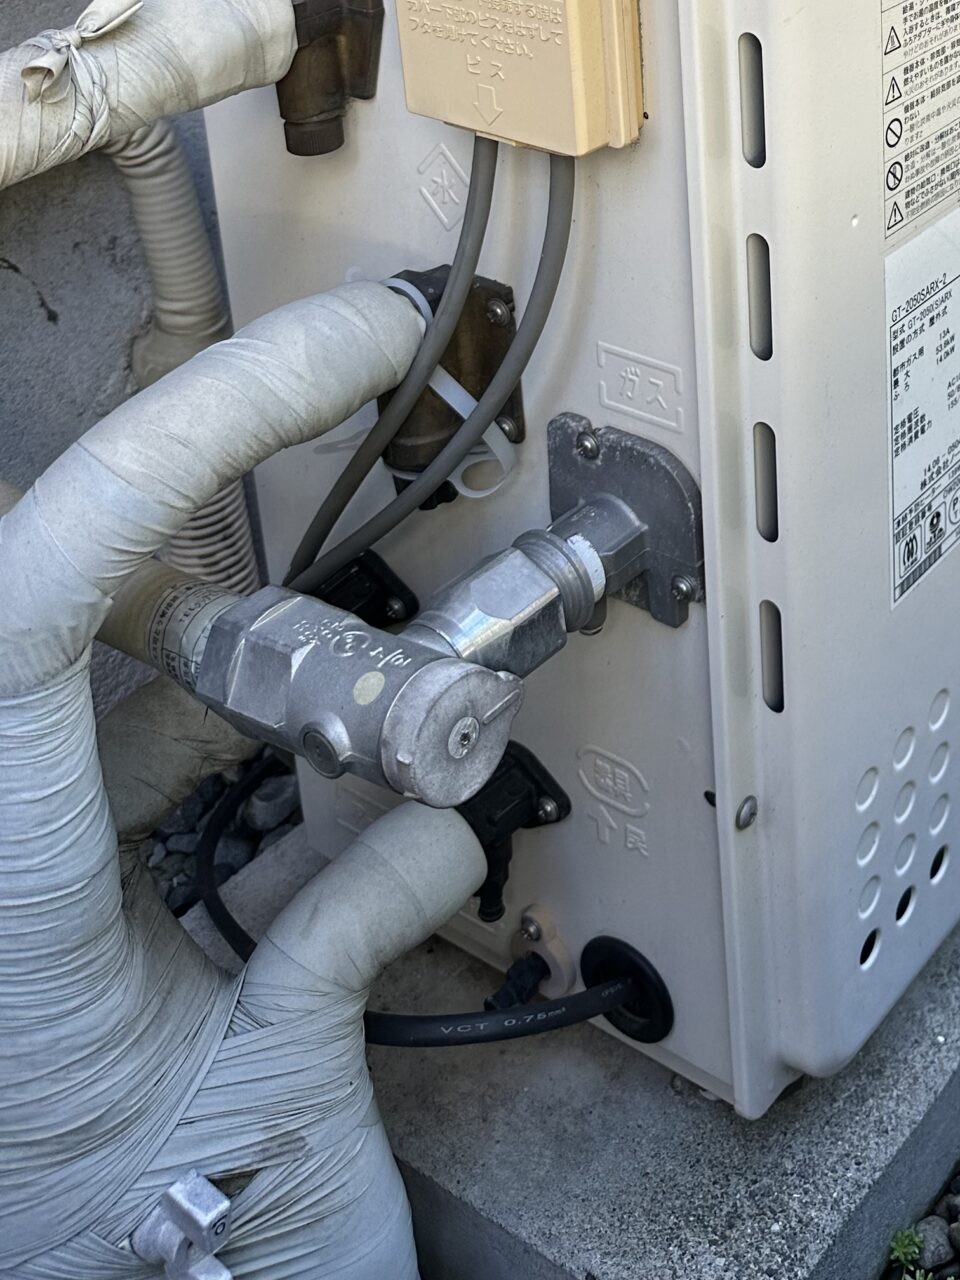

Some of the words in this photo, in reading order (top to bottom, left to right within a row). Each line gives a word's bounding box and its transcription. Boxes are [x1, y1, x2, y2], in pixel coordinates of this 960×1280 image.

[903, 108, 919, 125] わない
[891, 270, 946, 324] GT-2050SARX-2
[892, 322, 905, 342] 型式
[892, 321, 925, 356] 設置の方式
[619, 366, 668, 411] ガス
[440, 1022, 488, 1035] VCT
